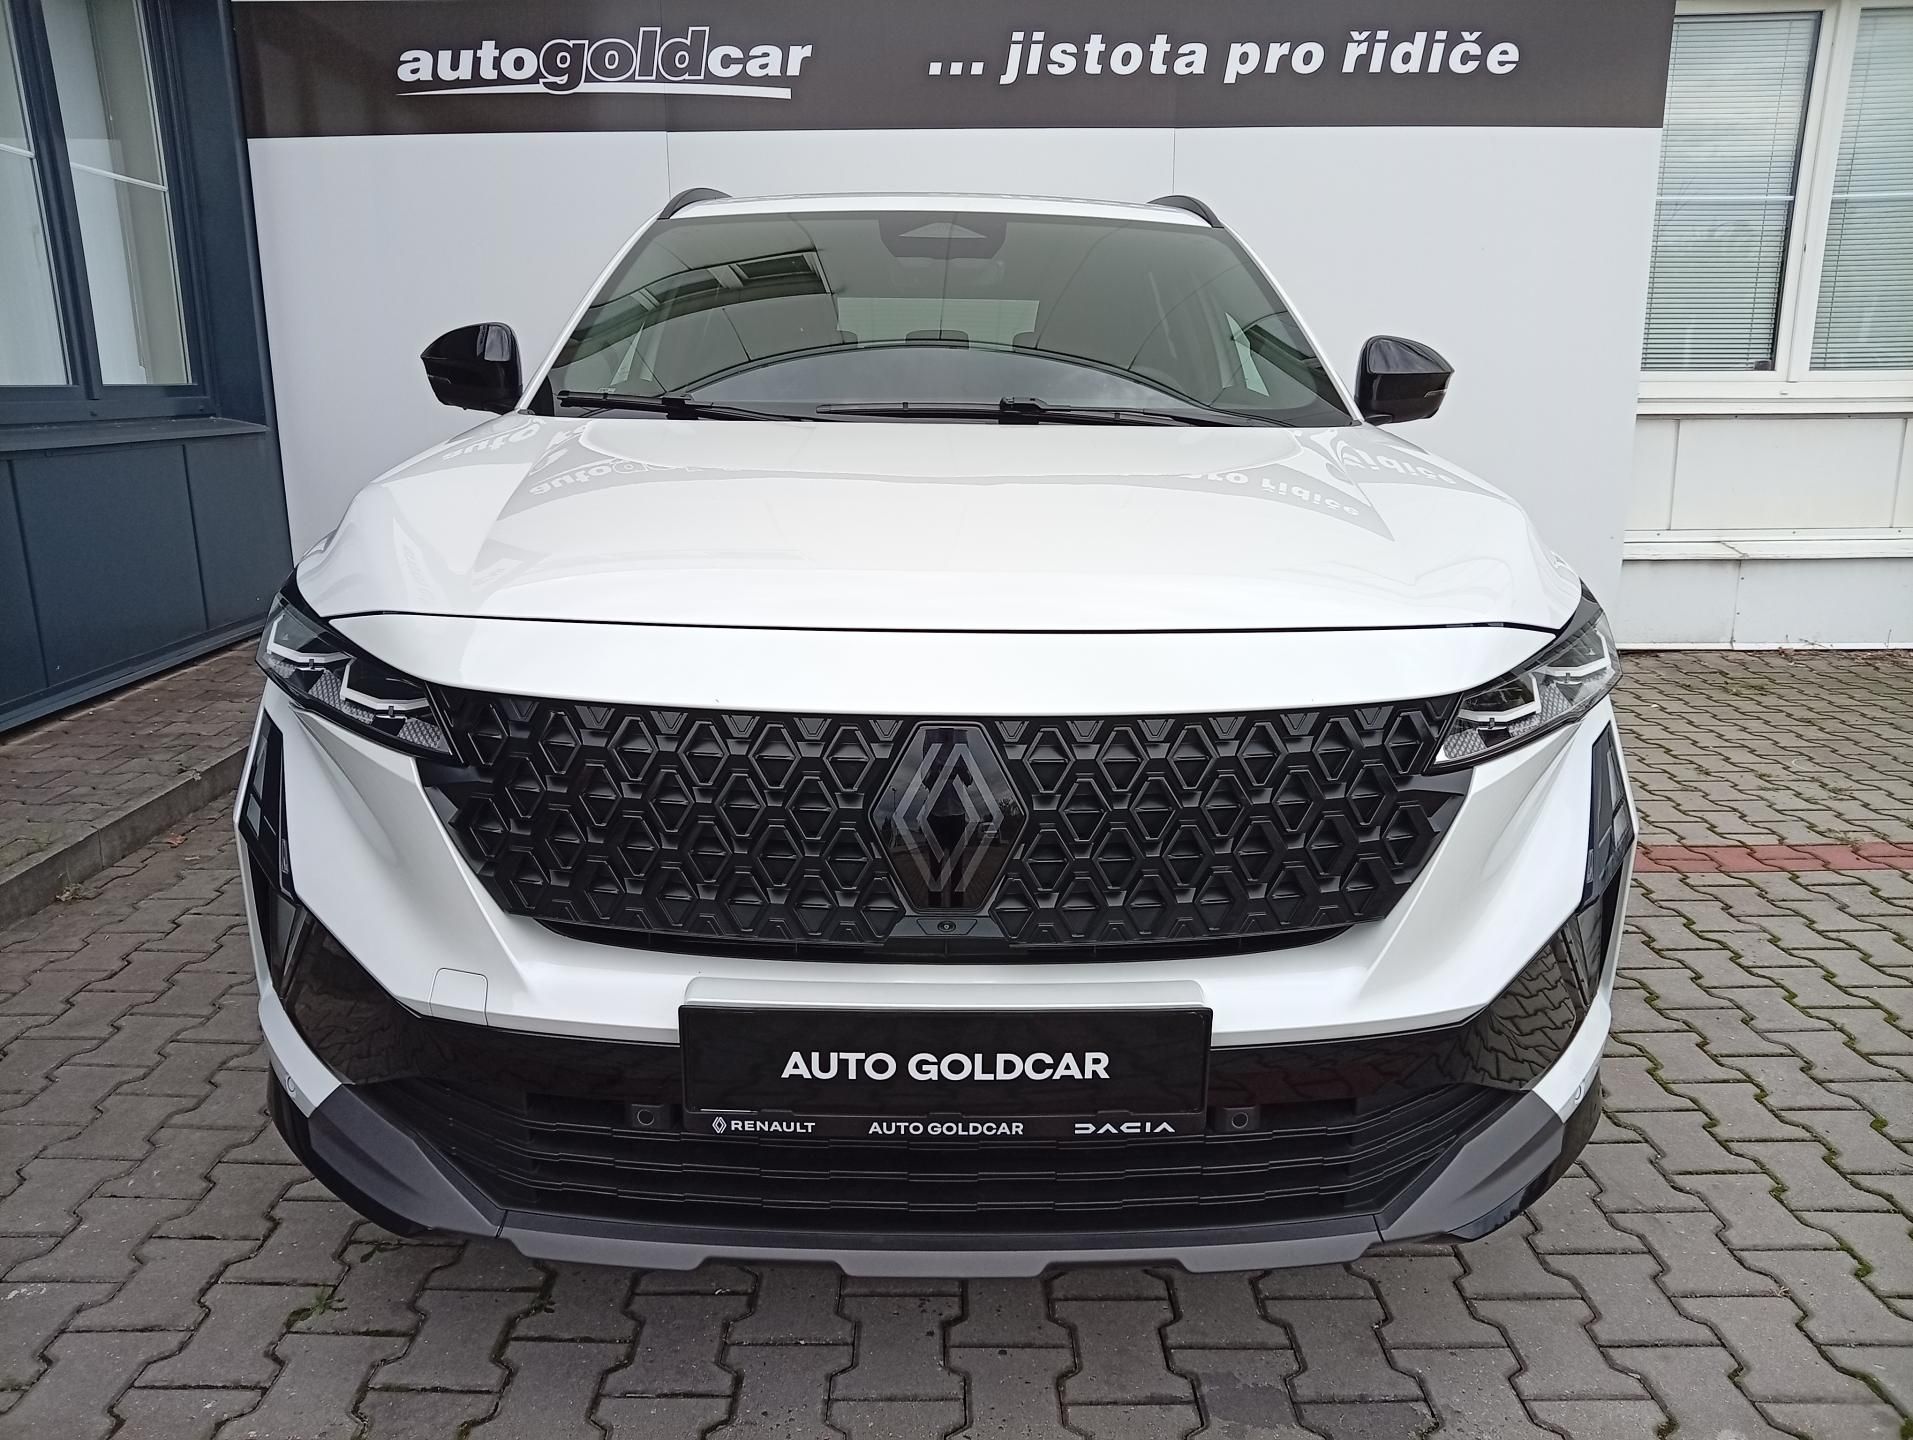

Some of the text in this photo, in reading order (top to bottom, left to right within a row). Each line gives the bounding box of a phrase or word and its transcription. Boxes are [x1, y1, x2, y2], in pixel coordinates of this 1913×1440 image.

[397, 27, 813, 95] autogoldcar
[999, 31, 1208, 84] jistota
[1224, 41, 1325, 84] pro
[1342, 30, 1520, 75] řidiče
[781, 1051, 1110, 1081] AUTO GOLDCAR
[731, 1120, 816, 1133] RENAULT
[869, 1121, 1024, 1135] AUTO GOLDCAR
[1074, 1121, 1176, 1134] DACIA
